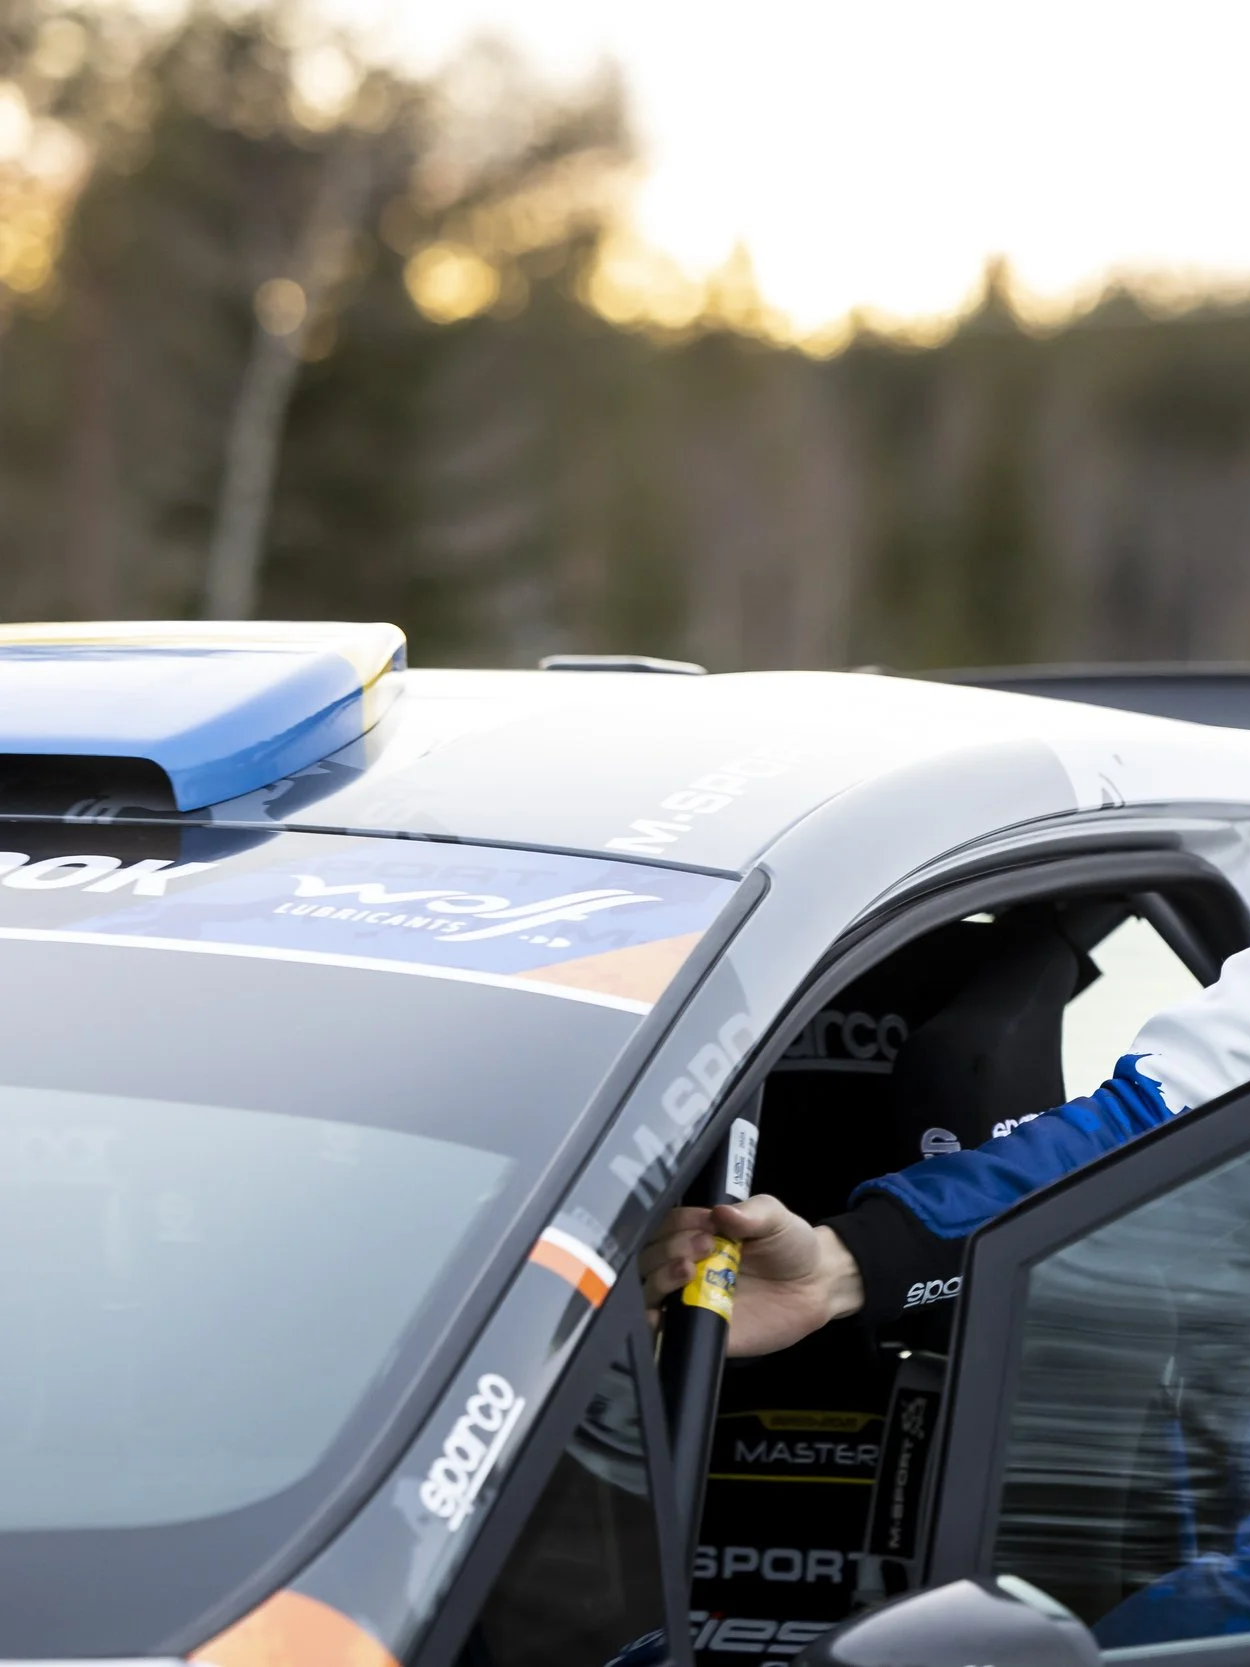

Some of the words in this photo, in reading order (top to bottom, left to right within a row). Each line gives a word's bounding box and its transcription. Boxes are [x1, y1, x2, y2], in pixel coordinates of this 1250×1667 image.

[272, 902, 468, 934] LUBRICANTS
[419, 1372, 526, 1532] sparco
[733, 1439, 880, 1466] MASTER
